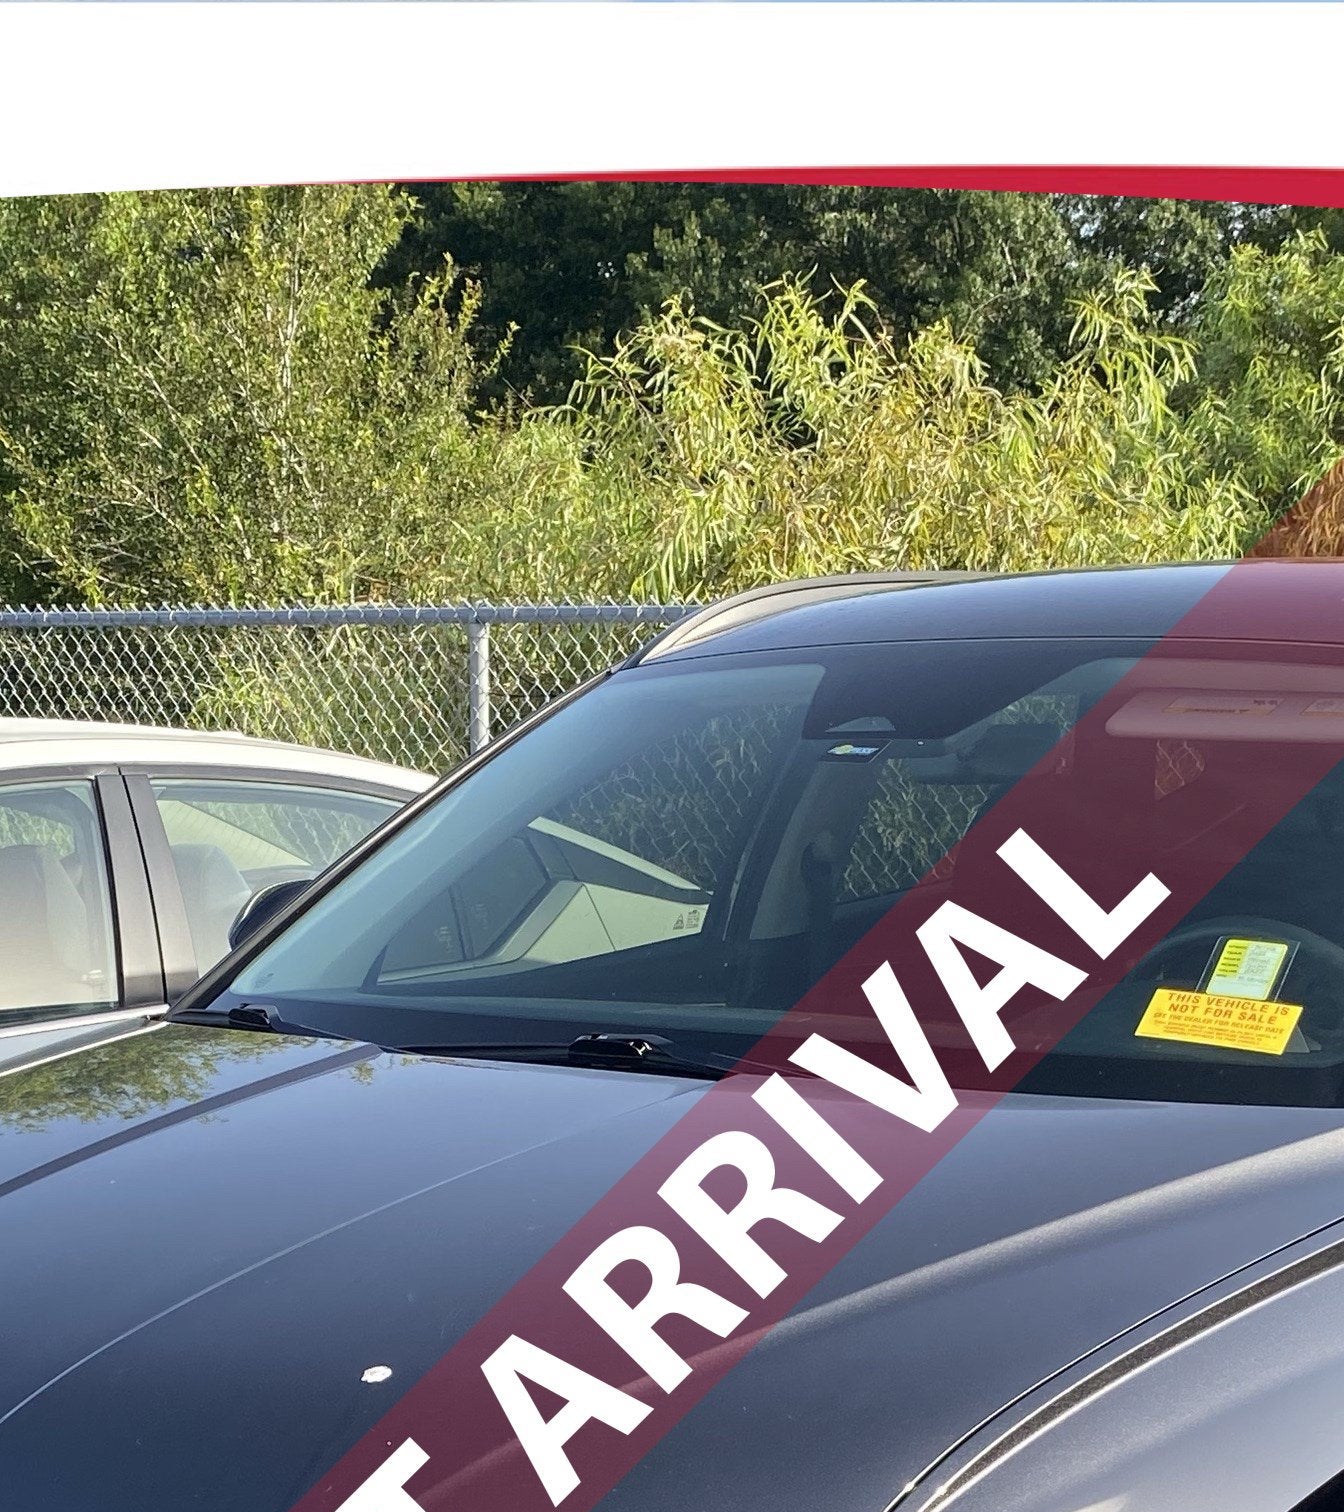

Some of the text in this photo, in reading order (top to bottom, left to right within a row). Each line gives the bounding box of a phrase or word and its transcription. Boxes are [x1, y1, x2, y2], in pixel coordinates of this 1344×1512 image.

[1168, 992, 1290, 1016] THIS VEHICLE IS
[1168, 1003, 1278, 1025] NOT FOR SALE
[1183, 1016, 1213, 1025] DEALER
